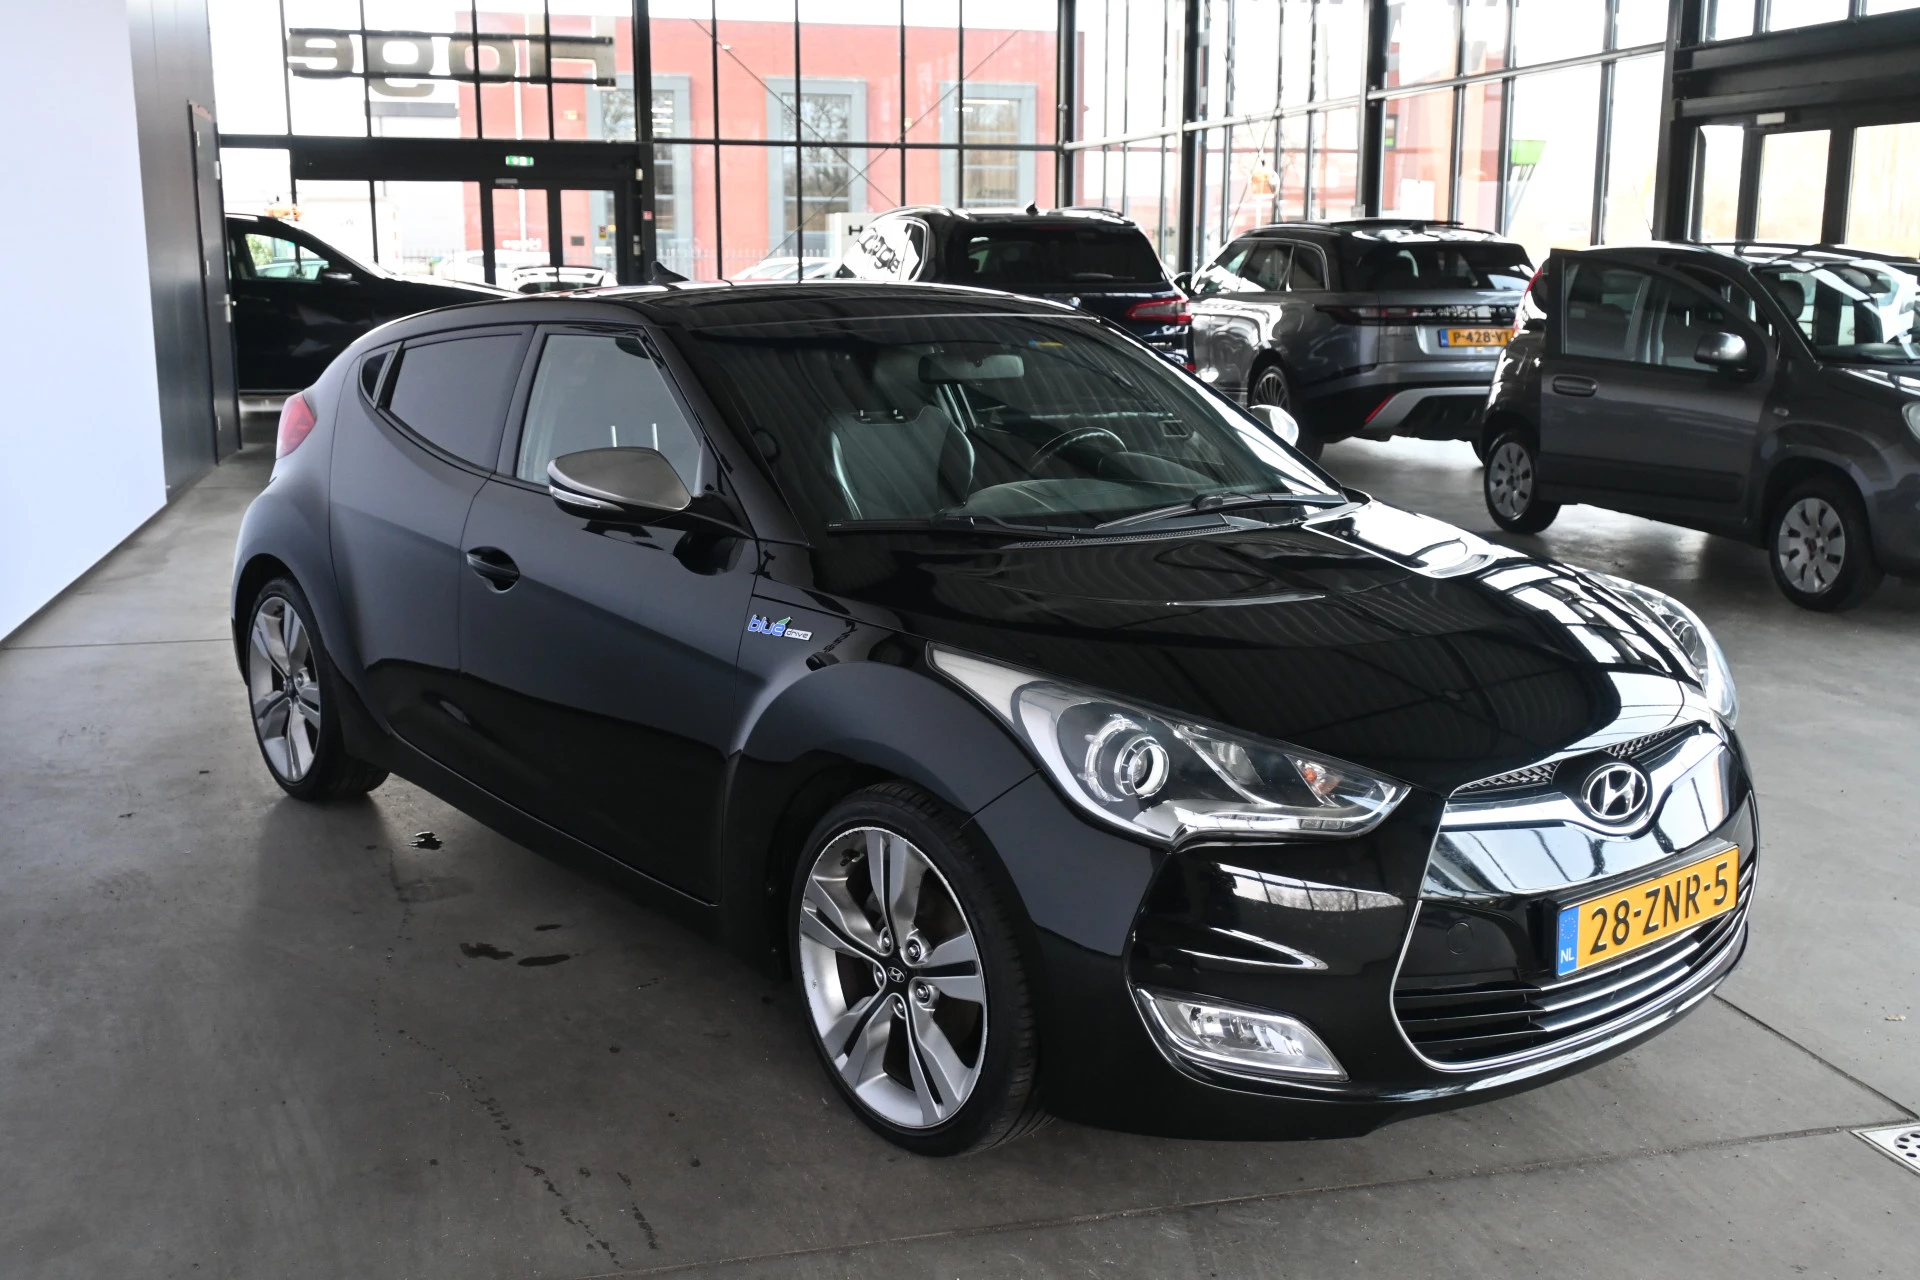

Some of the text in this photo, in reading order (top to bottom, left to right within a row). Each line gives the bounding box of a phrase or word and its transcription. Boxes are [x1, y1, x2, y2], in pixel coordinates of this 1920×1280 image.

[748, 614, 809, 639] blue drive
[1589, 861, 1729, 956] 28-ZNR-5
[1560, 947, 1575, 964] NL
